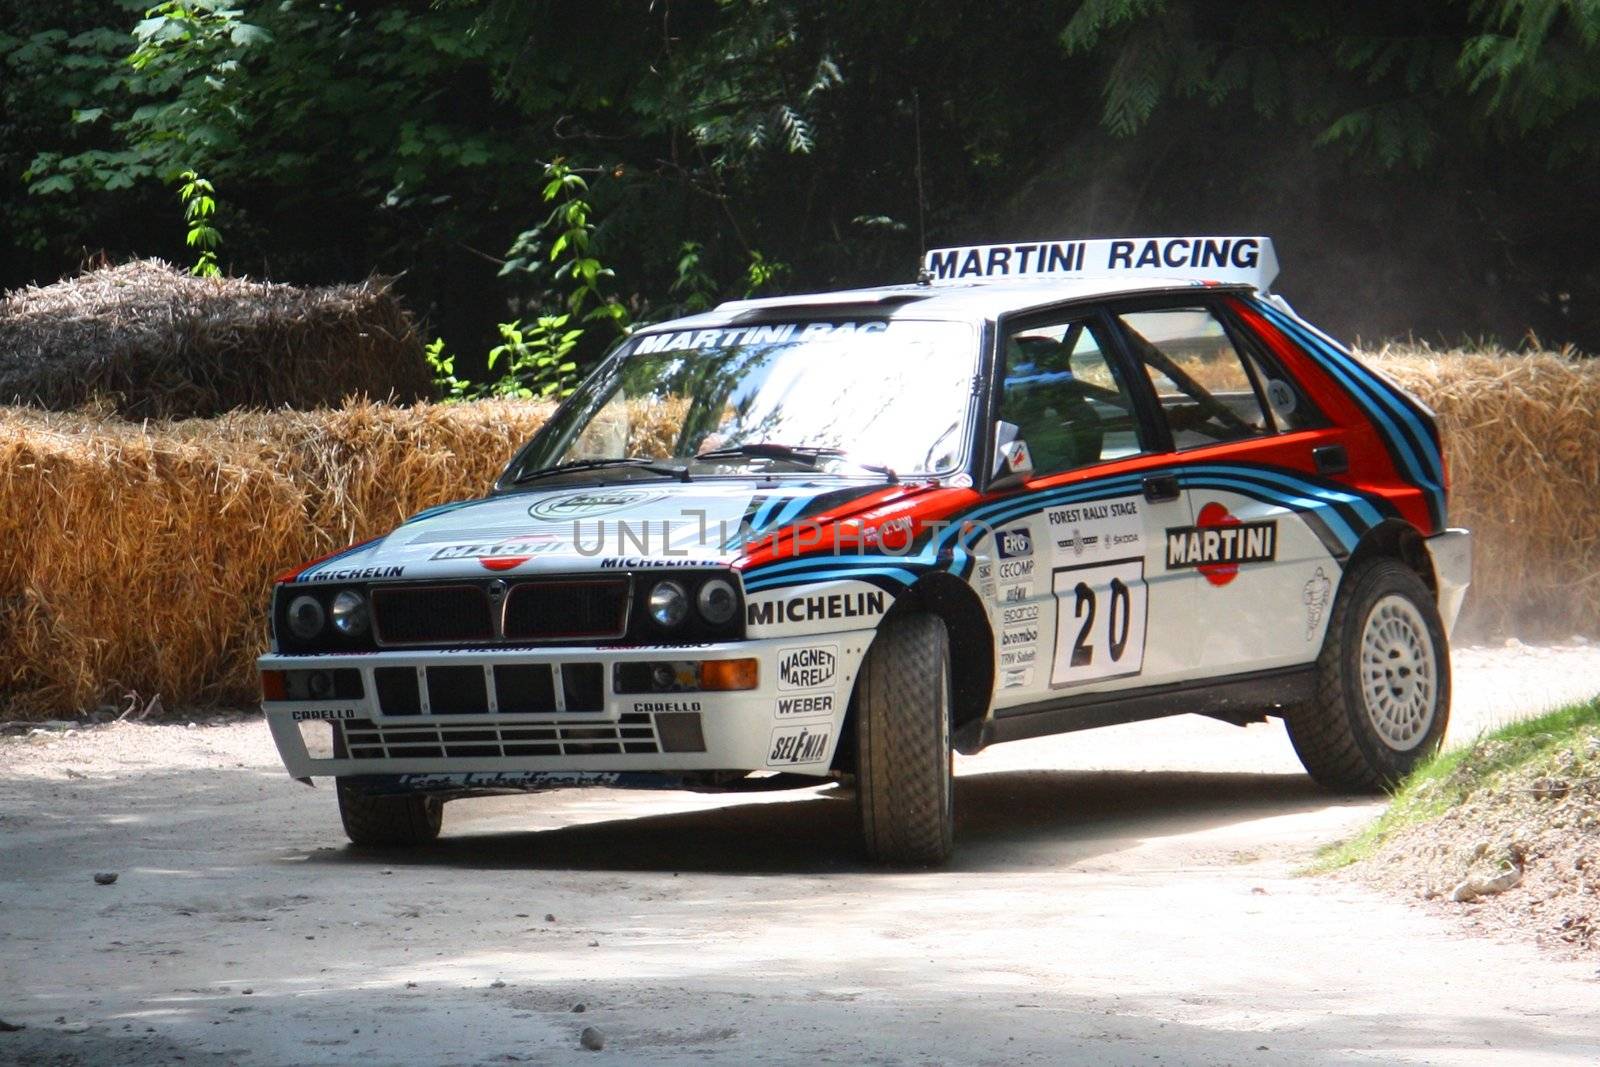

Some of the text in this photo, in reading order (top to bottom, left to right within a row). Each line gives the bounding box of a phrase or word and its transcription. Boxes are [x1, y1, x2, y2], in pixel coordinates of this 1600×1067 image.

[929, 238, 1259, 280] MARTINI RACING
[632, 322, 797, 356] MARTINI
[1048, 501, 1138, 526] FOREST RALLY STAGE
[1003, 533, 1026, 554] ERG
[1168, 526, 1273, 565] MARTINI
[313, 564, 406, 582] MICHELIN
[1000, 559, 1034, 579] CECOMP
[746, 590, 884, 626] MICHELIN
[1004, 605, 1040, 623] sparco
[1069, 576, 1131, 668] 20
[1002, 627, 1038, 646] brembo
[780, 649, 835, 674] MAGNETI
[780, 663, 835, 687] MARELLI
[778, 695, 833, 714] WEBER
